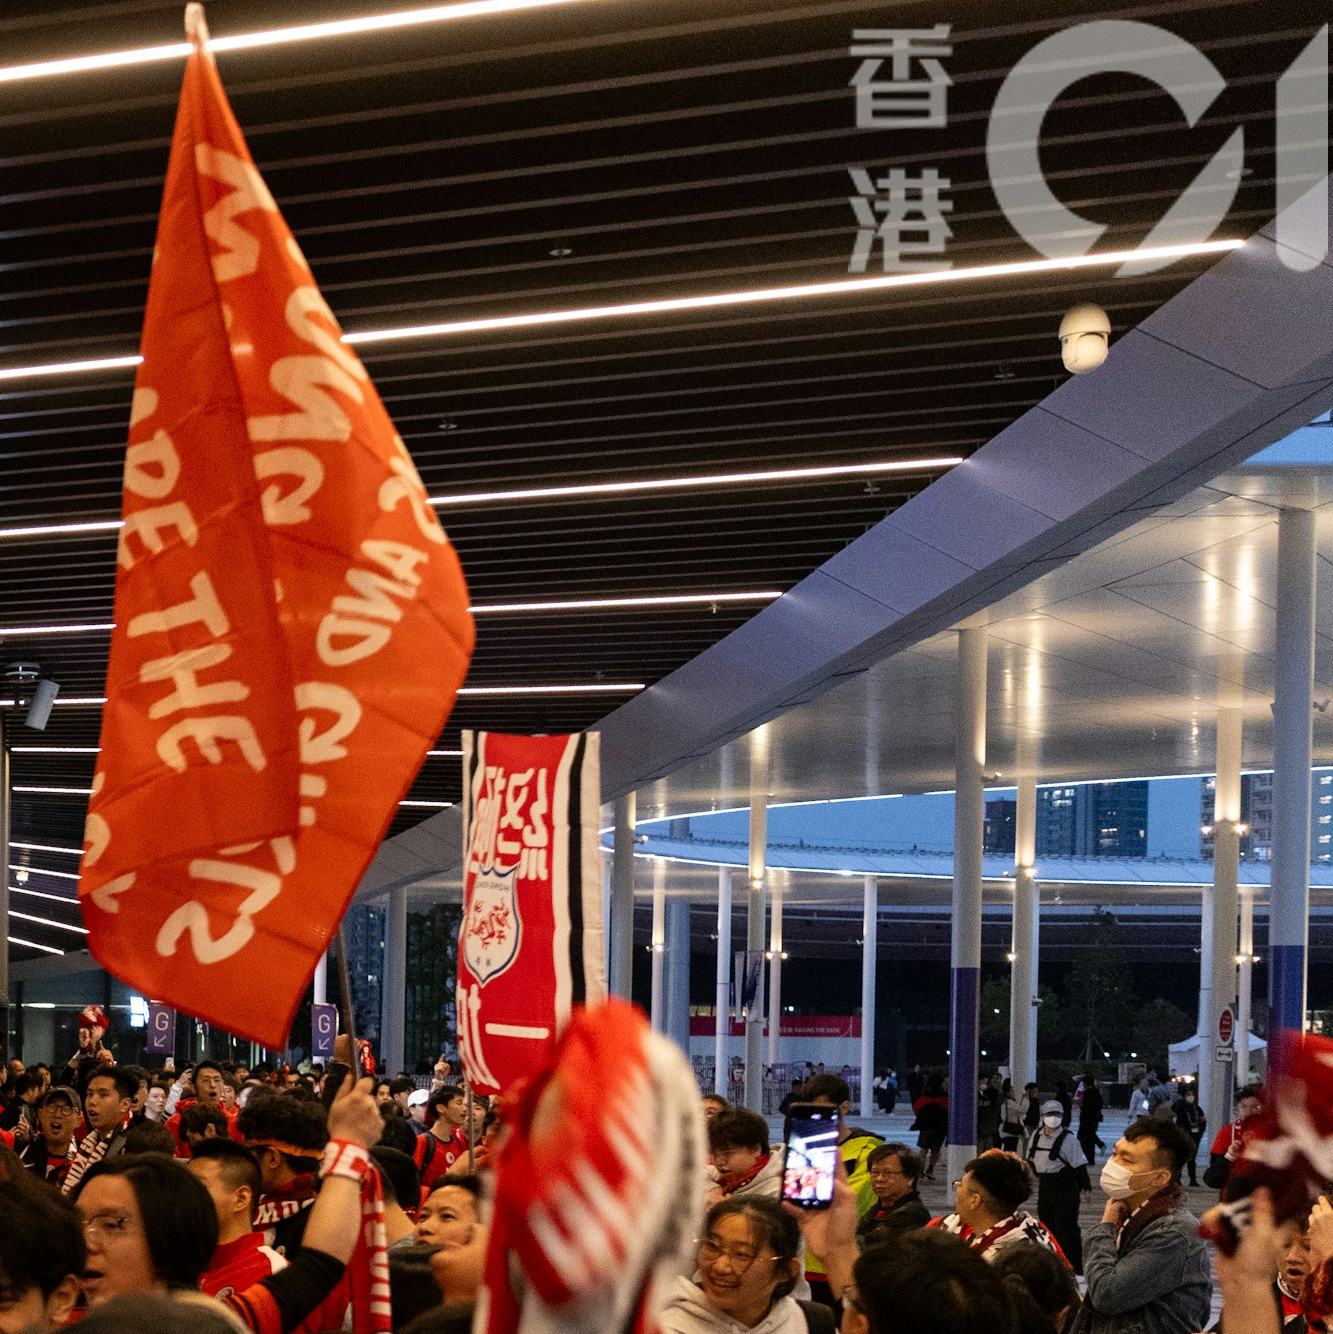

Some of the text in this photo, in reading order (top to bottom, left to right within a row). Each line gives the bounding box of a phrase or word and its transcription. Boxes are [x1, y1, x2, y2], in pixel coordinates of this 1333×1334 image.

[127, 570, 266, 773] THE
[155, 1012, 169, 1031] G
[318, 1014, 331, 1034] G
